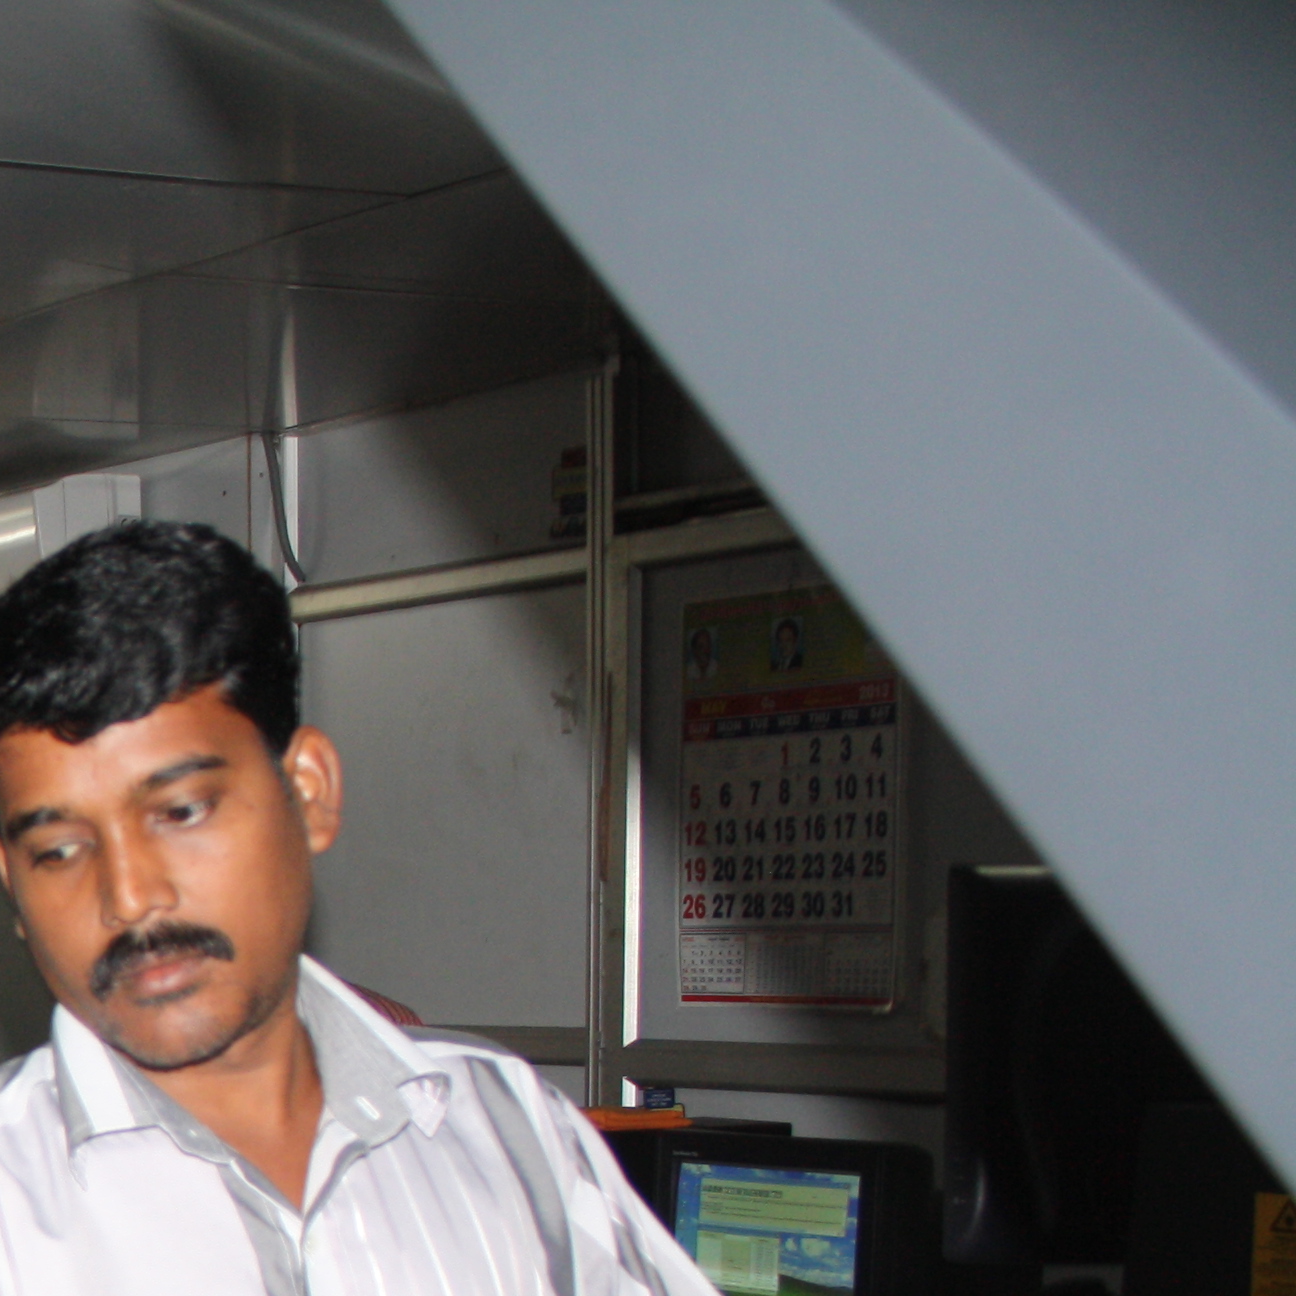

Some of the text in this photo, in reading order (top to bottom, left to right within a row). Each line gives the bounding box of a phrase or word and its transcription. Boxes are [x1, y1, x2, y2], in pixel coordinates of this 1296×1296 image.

[780, 733, 884, 767] 1 2 3 4
[689, 772, 888, 810] 5 6 7 8 9 10 11
[684, 811, 888, 847] 12 13 14 15 16 17 18
[684, 850, 887, 884] 19 20 21 22 23 24 25
[682, 890, 854, 920] 26 27 28 29 30 31
